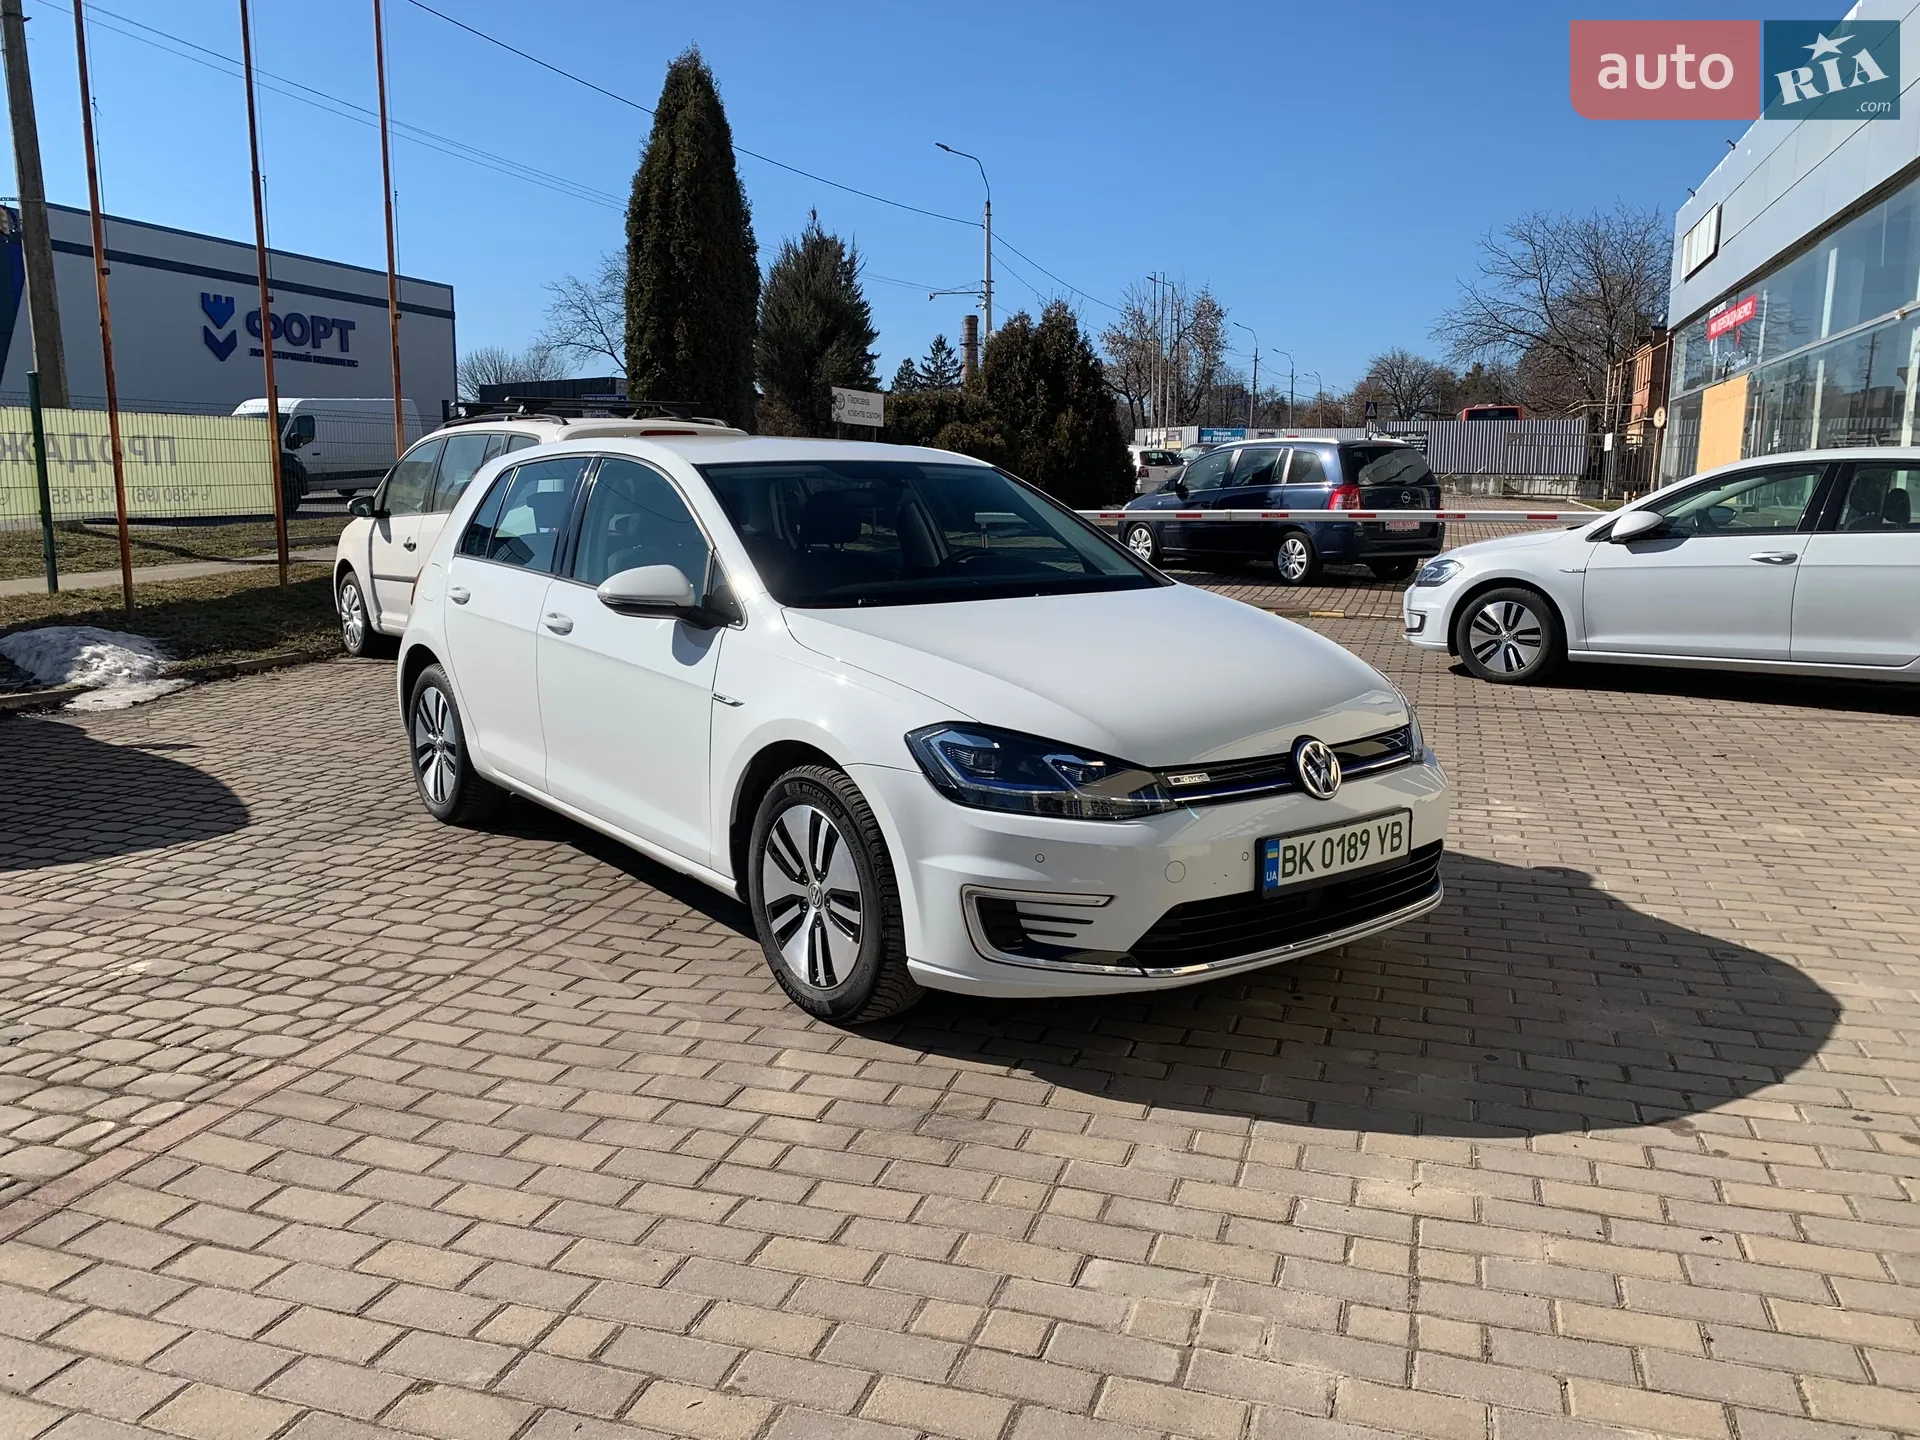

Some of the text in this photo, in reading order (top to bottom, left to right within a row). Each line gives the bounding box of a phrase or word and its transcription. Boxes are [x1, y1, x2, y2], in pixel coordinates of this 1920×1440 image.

[245, 306, 356, 353] ФОРТ
[801, 784, 842, 817] MICHELIN
[1281, 820, 1403, 879] BK 0189 YB
[1266, 869, 1278, 882] UA
